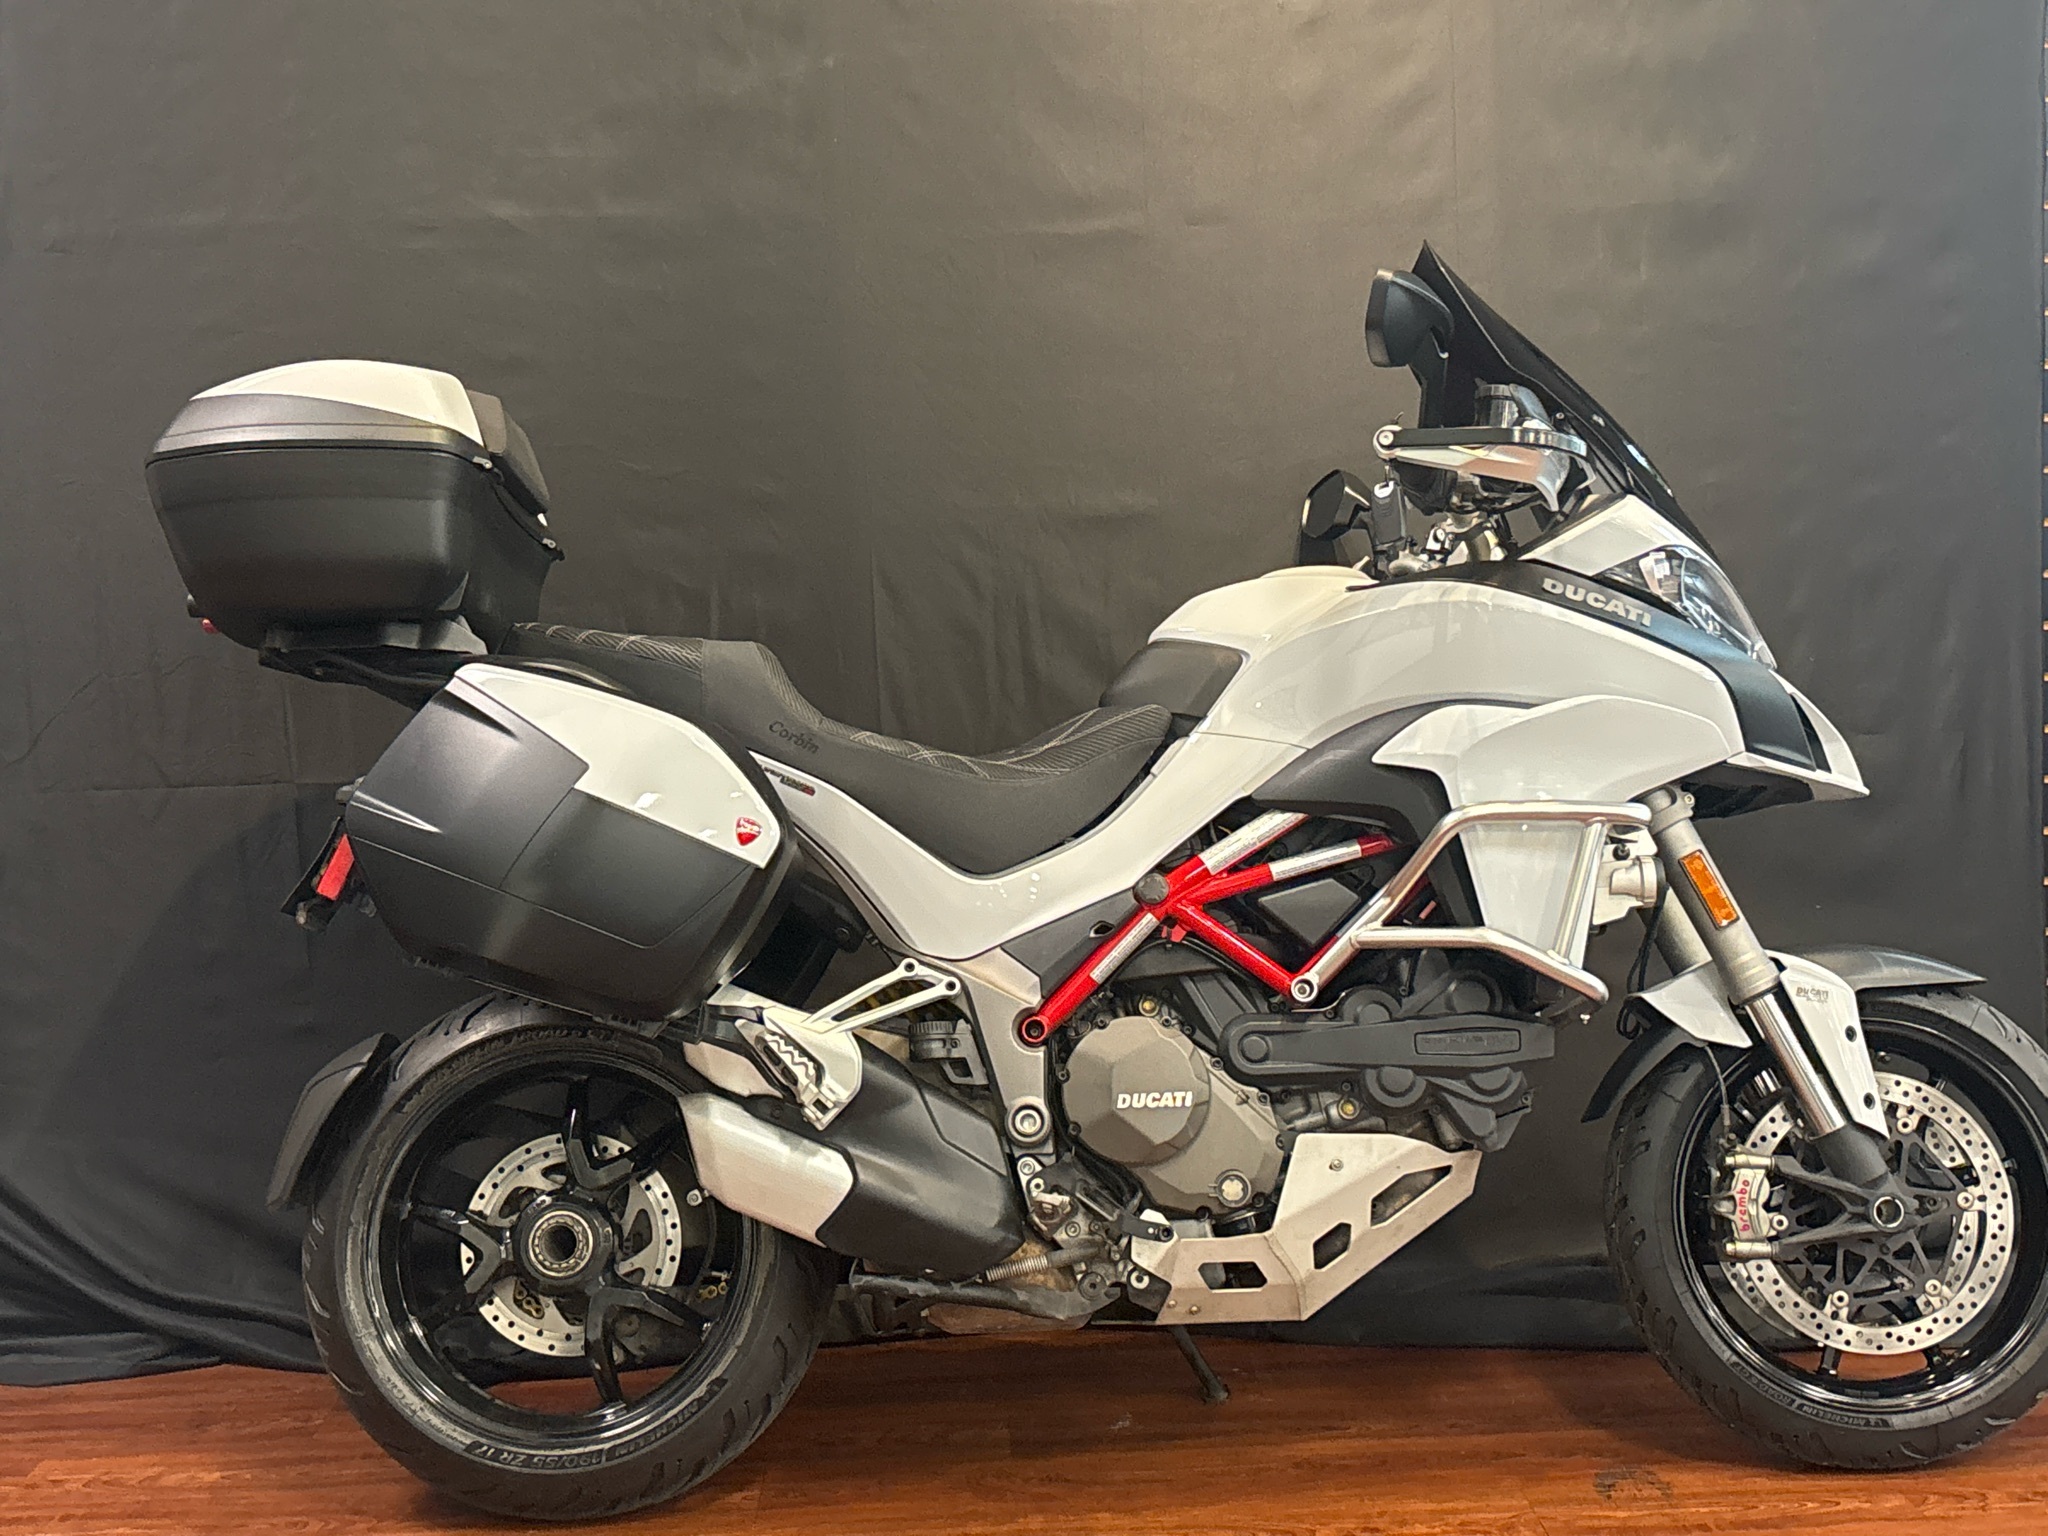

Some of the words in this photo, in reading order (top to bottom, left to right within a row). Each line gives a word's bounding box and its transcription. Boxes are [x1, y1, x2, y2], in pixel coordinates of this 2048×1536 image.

[1542, 578, 1652, 628] DUCATI
[769, 721, 820, 754] Corbin
[1116, 1090, 1193, 1109] DUCATI
[1736, 1179, 1751, 1232] brembo
[1802, 1405, 1866, 1427] MICHELIN
[614, 1400, 699, 1457] MICHELIN
[473, 1444, 496, 1458] 17
[499, 1450, 528, 1466] ZR
[533, 1450, 602, 1469] 190/55
